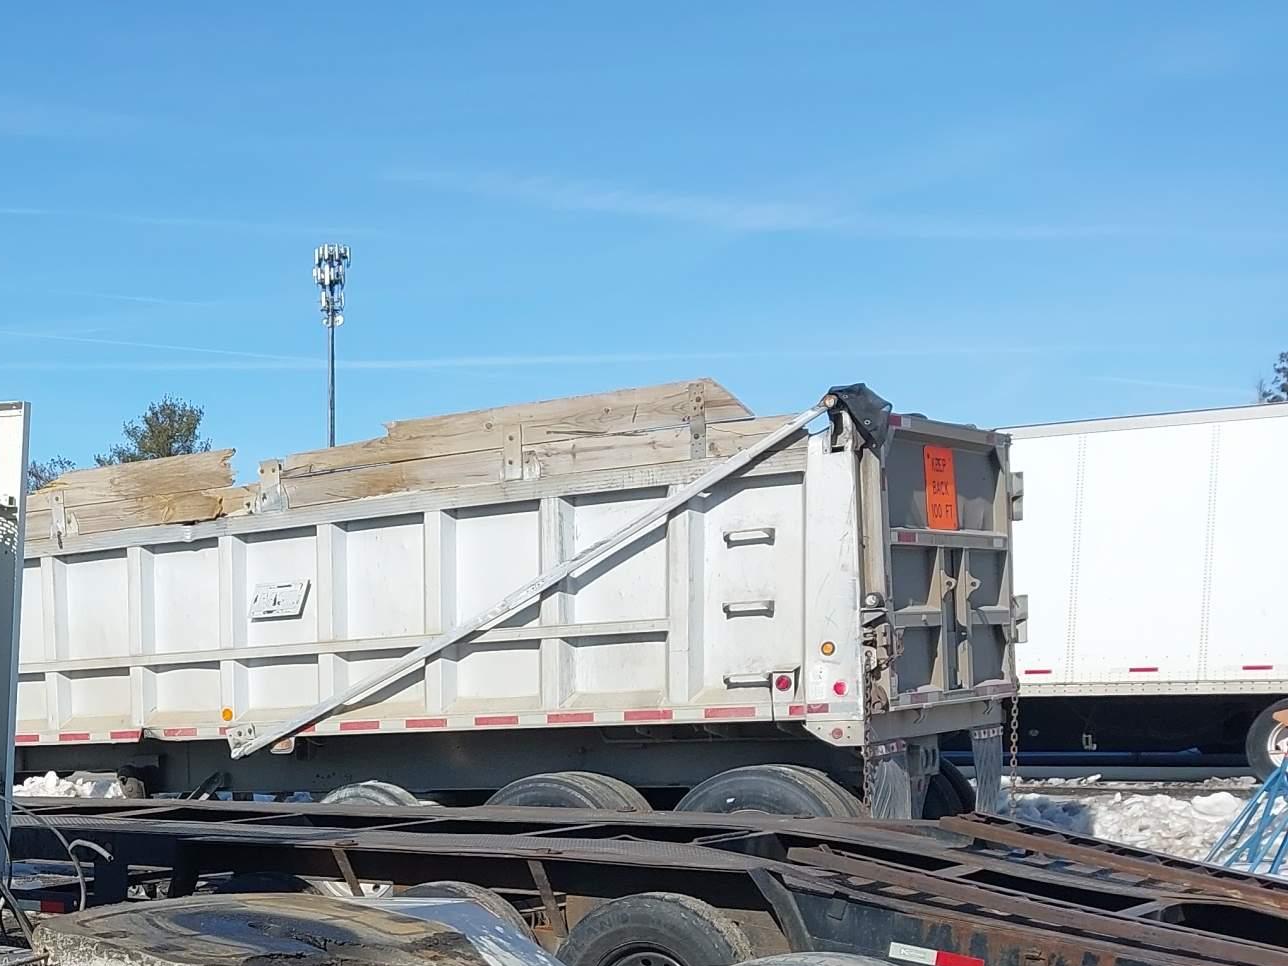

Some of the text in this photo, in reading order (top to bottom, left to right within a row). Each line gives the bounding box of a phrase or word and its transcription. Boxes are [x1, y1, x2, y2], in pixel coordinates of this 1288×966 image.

[932, 480, 950, 496] BACK
[931, 503, 953, 519] 100 FT
